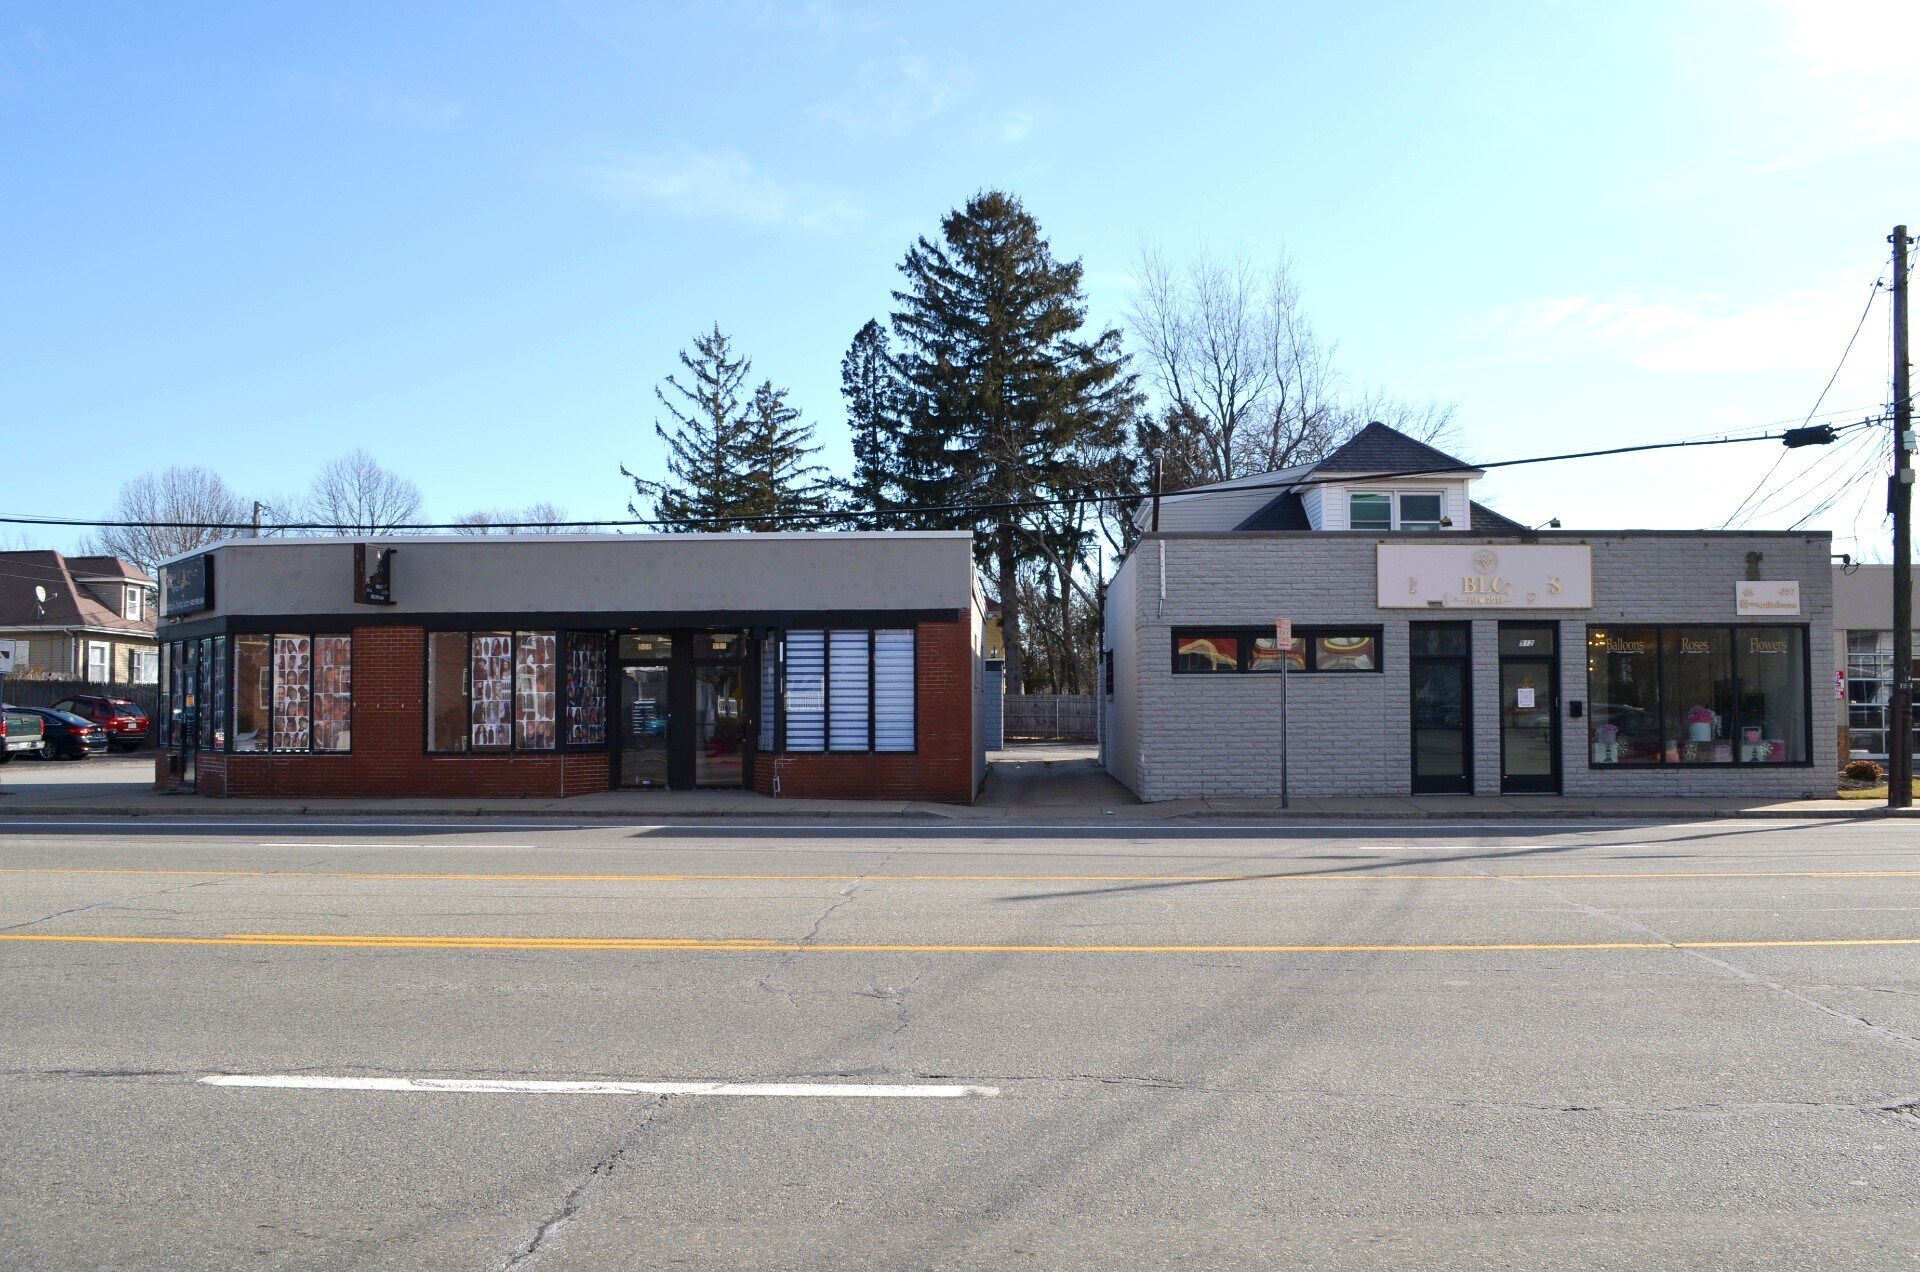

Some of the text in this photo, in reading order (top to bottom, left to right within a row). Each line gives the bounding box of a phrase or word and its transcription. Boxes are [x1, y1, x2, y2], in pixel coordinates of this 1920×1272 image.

[1606, 638, 1644, 651] Balloons
[1682, 638, 1709, 650] Roses
[1750, 638, 1787, 650] Flowers
